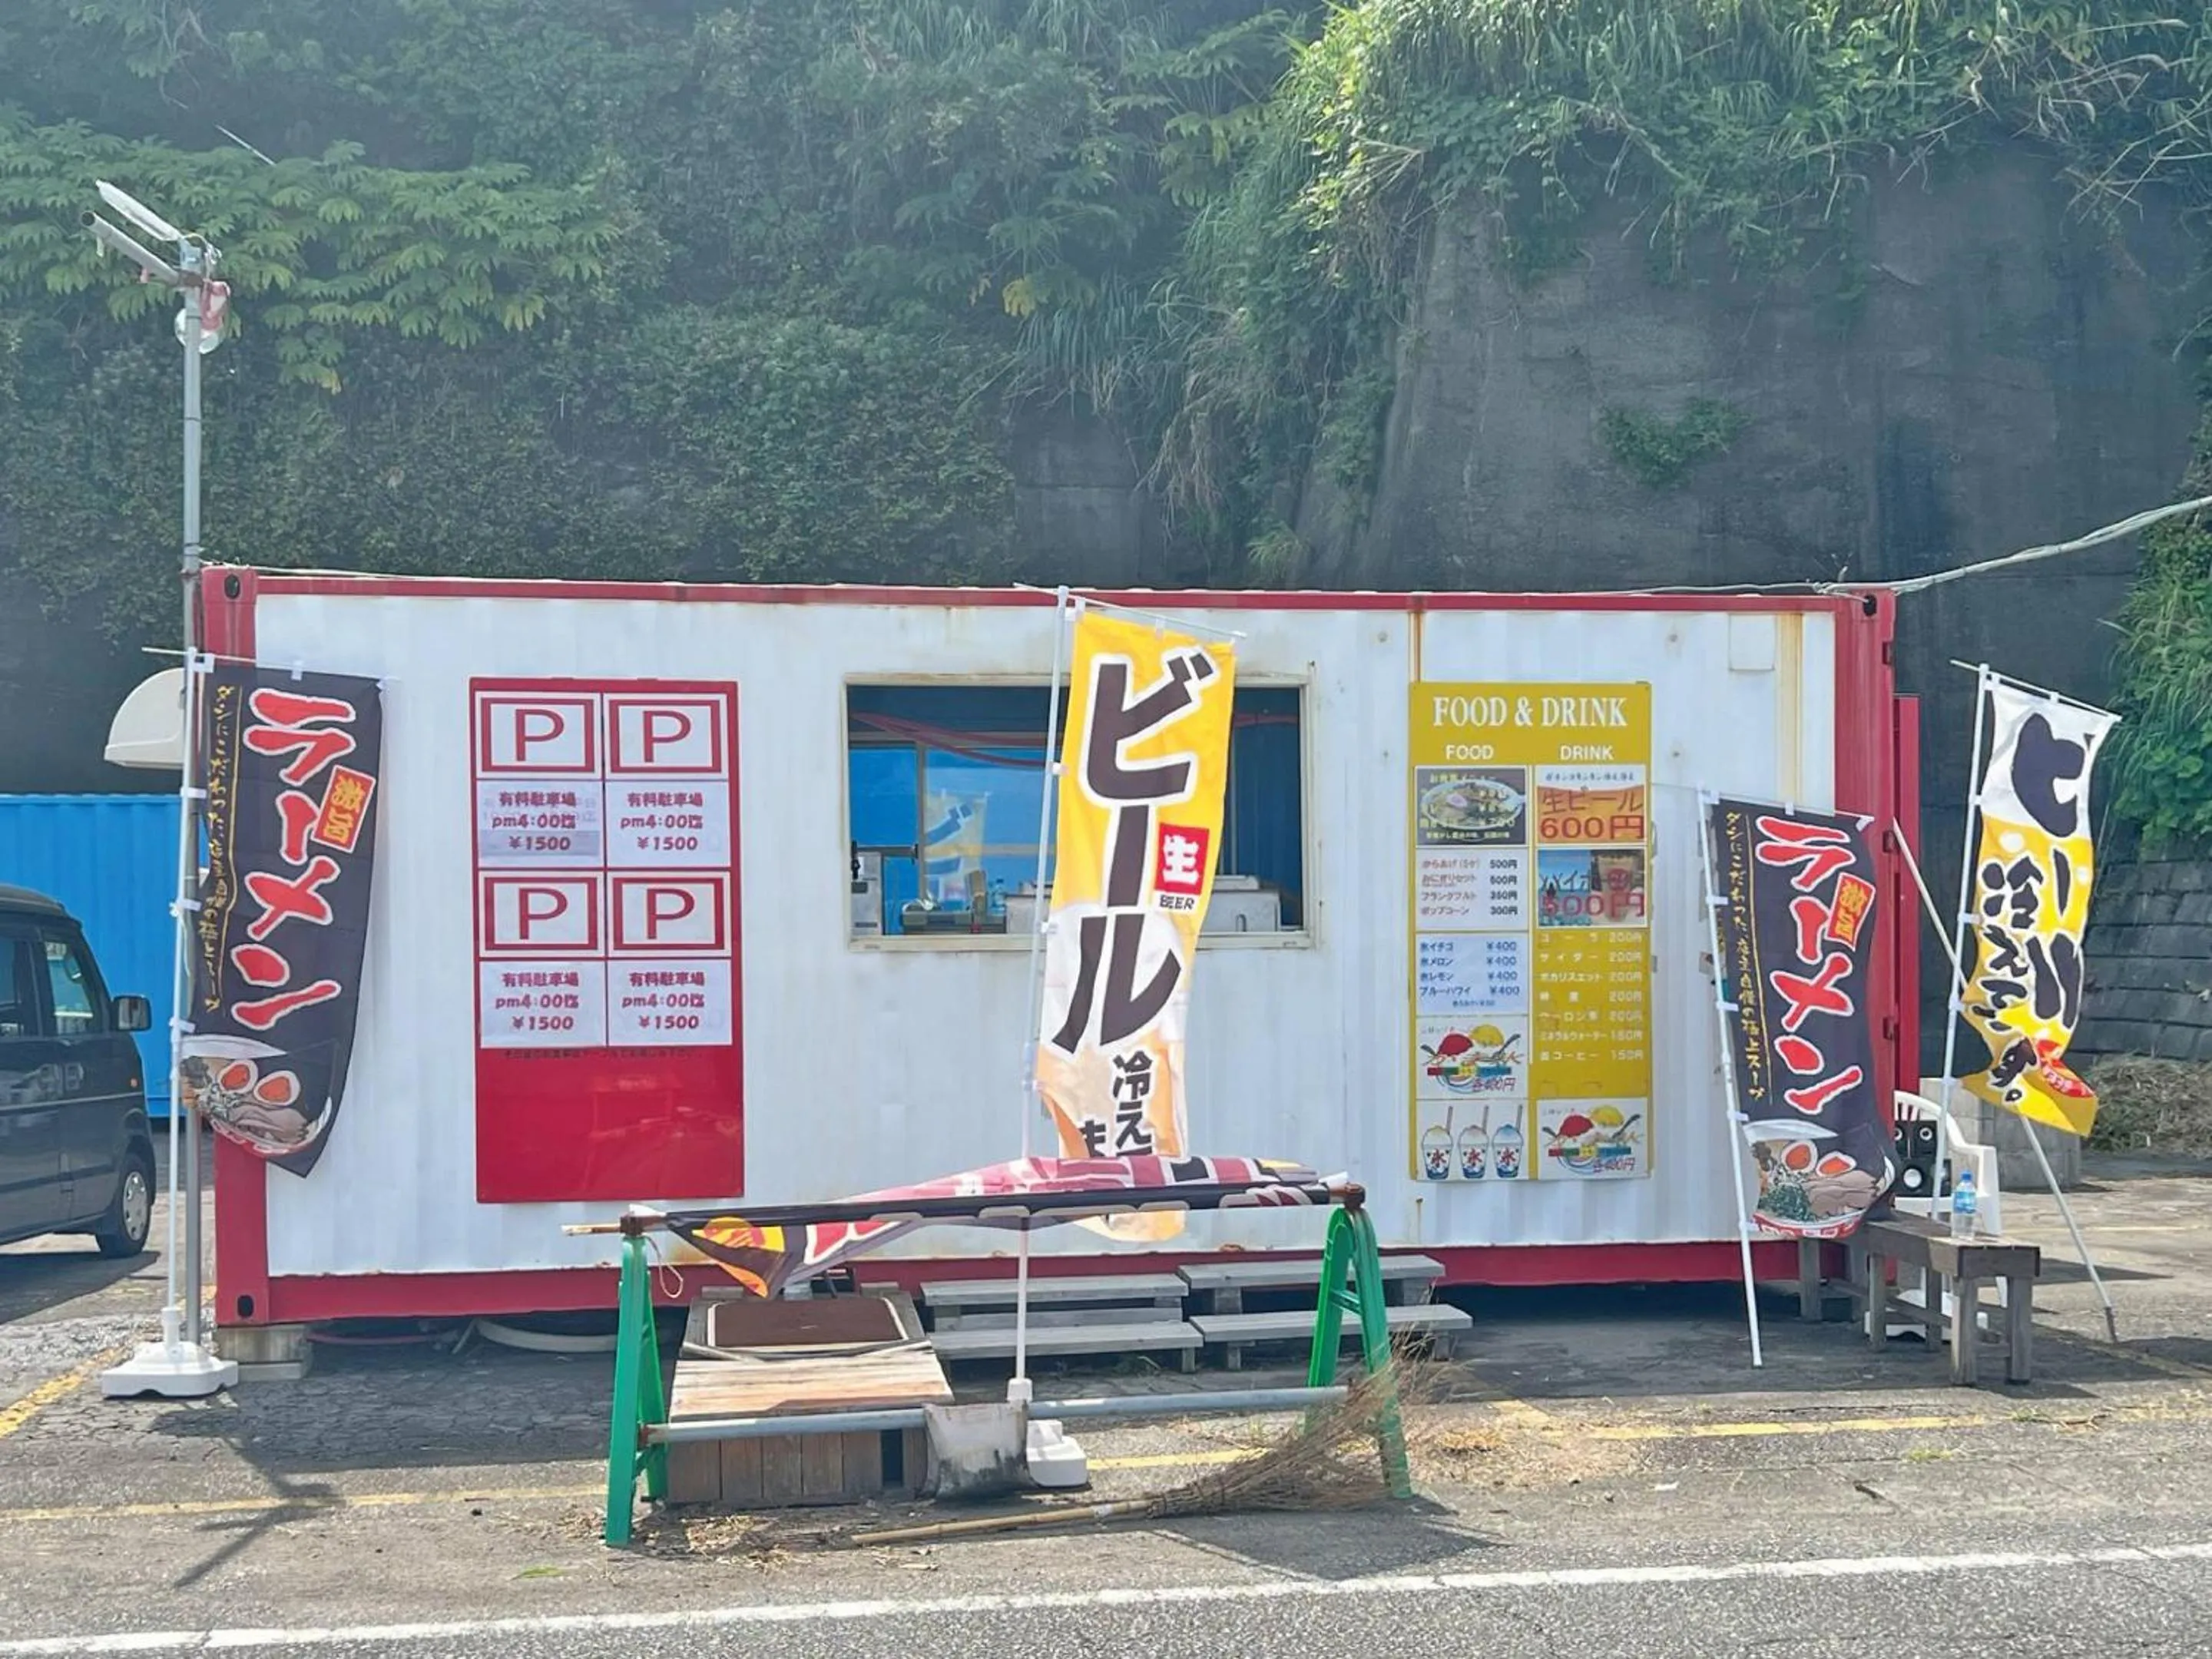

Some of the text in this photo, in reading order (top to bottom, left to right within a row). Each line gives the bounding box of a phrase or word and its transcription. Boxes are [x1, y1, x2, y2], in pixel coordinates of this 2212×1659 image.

[1432, 696, 1628, 727] FOOD & DRINK
[515, 709, 565, 761] P
[643, 710, 691, 763] P
[1445, 744, 1494, 760] FOOD
[1560, 744, 1614, 760] DRINK
[499, 791, 576, 806] 有料駐車場
[627, 792, 703, 806] 有料駐車場
[1542, 789, 1644, 815] 生ビール
[1541, 815, 1644, 839] 600円
[508, 836, 571, 851] ¥1500
[637, 836, 698, 851] ¥1500
[1052, 651, 1214, 1054] ビール
[232, 688, 356, 1029] ラーメン
[1163, 834, 1199, 885] 生
[1490, 859, 1518, 869] 500円
[1159, 895, 1195, 910] BEER
[519, 888, 568, 939] P
[647, 888, 695, 939] P
[1756, 815, 1863, 1114] ラーメン
[502, 972, 578, 986] 有料駐車場
[629, 972, 705, 986] 有料駐車場
[512, 1015, 575, 1030] ¥1500
[639, 1015, 700, 1030] ¥1500
[1113, 1051, 1153, 1157] 冷え
